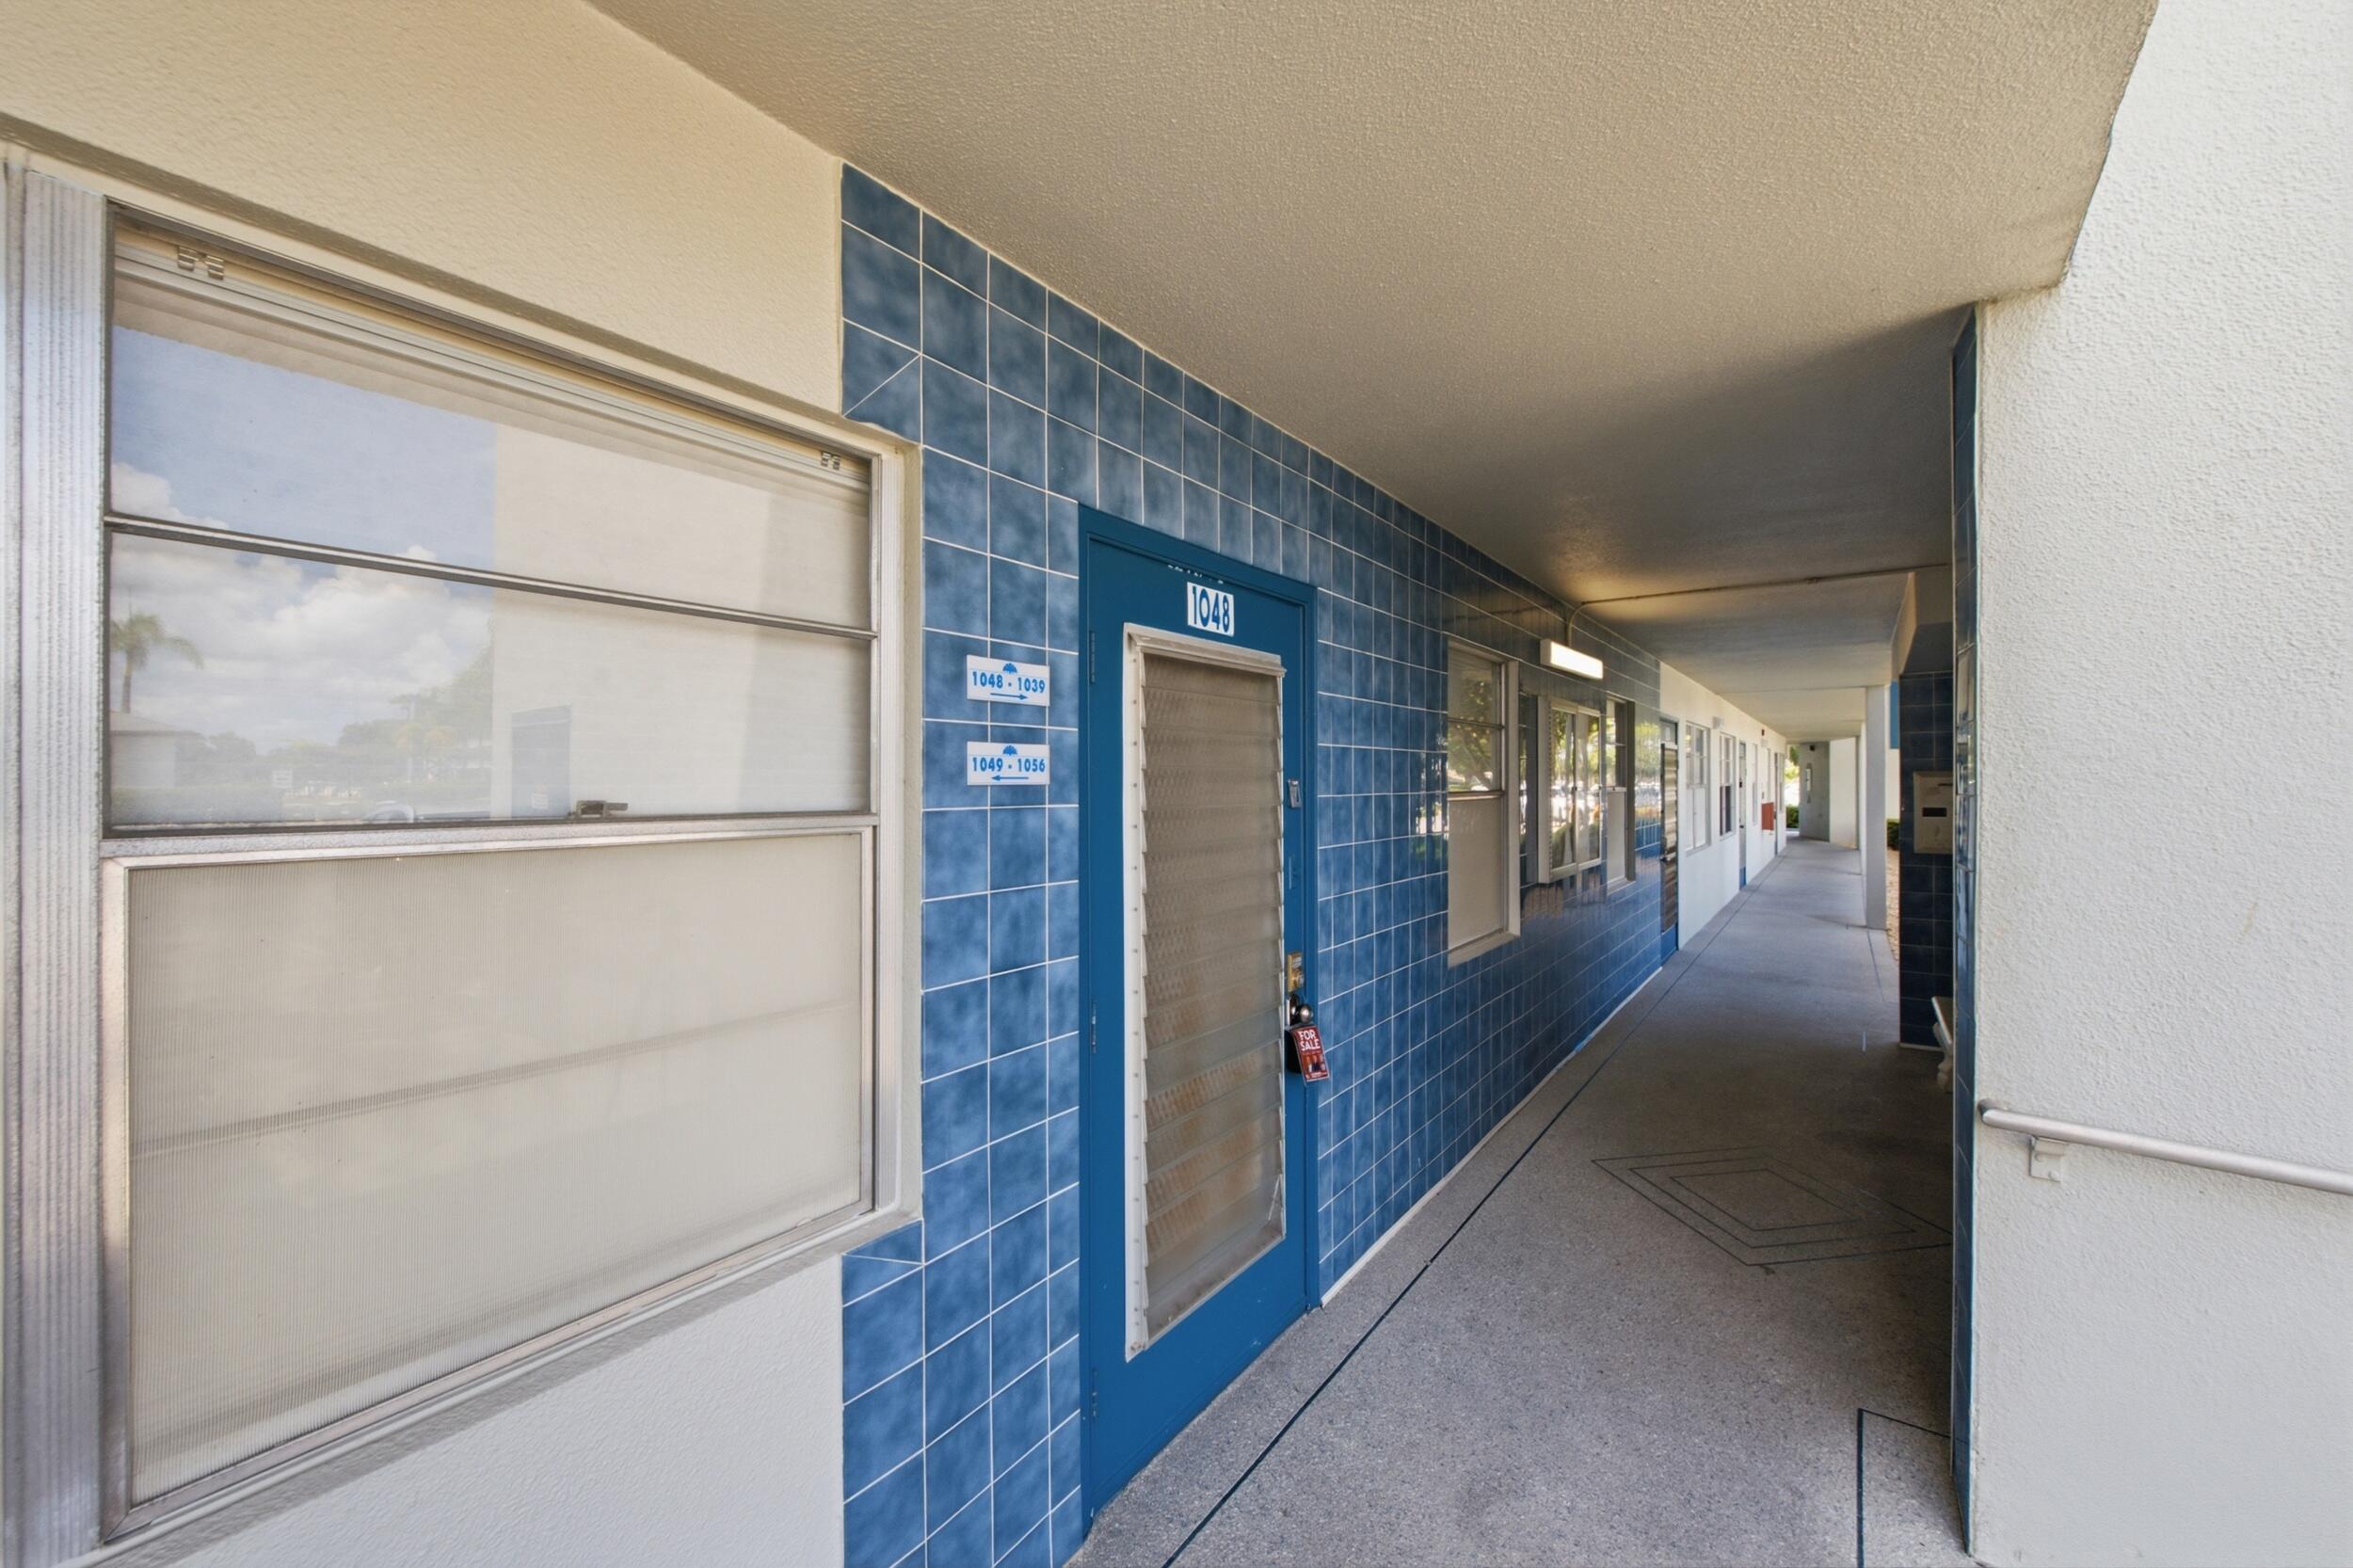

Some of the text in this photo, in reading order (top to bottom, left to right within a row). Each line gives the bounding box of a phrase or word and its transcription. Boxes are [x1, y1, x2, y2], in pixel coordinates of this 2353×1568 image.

[1192, 585, 1230, 632] 1048
[971, 671, 1003, 689] 1048
[1017, 677, 1046, 694] 1039
[971, 757, 1003, 773] 1049
[1017, 758, 1046, 773] 1056
[1298, 1030, 1316, 1040] FOR
[1300, 1038, 1321, 1051] SALE
